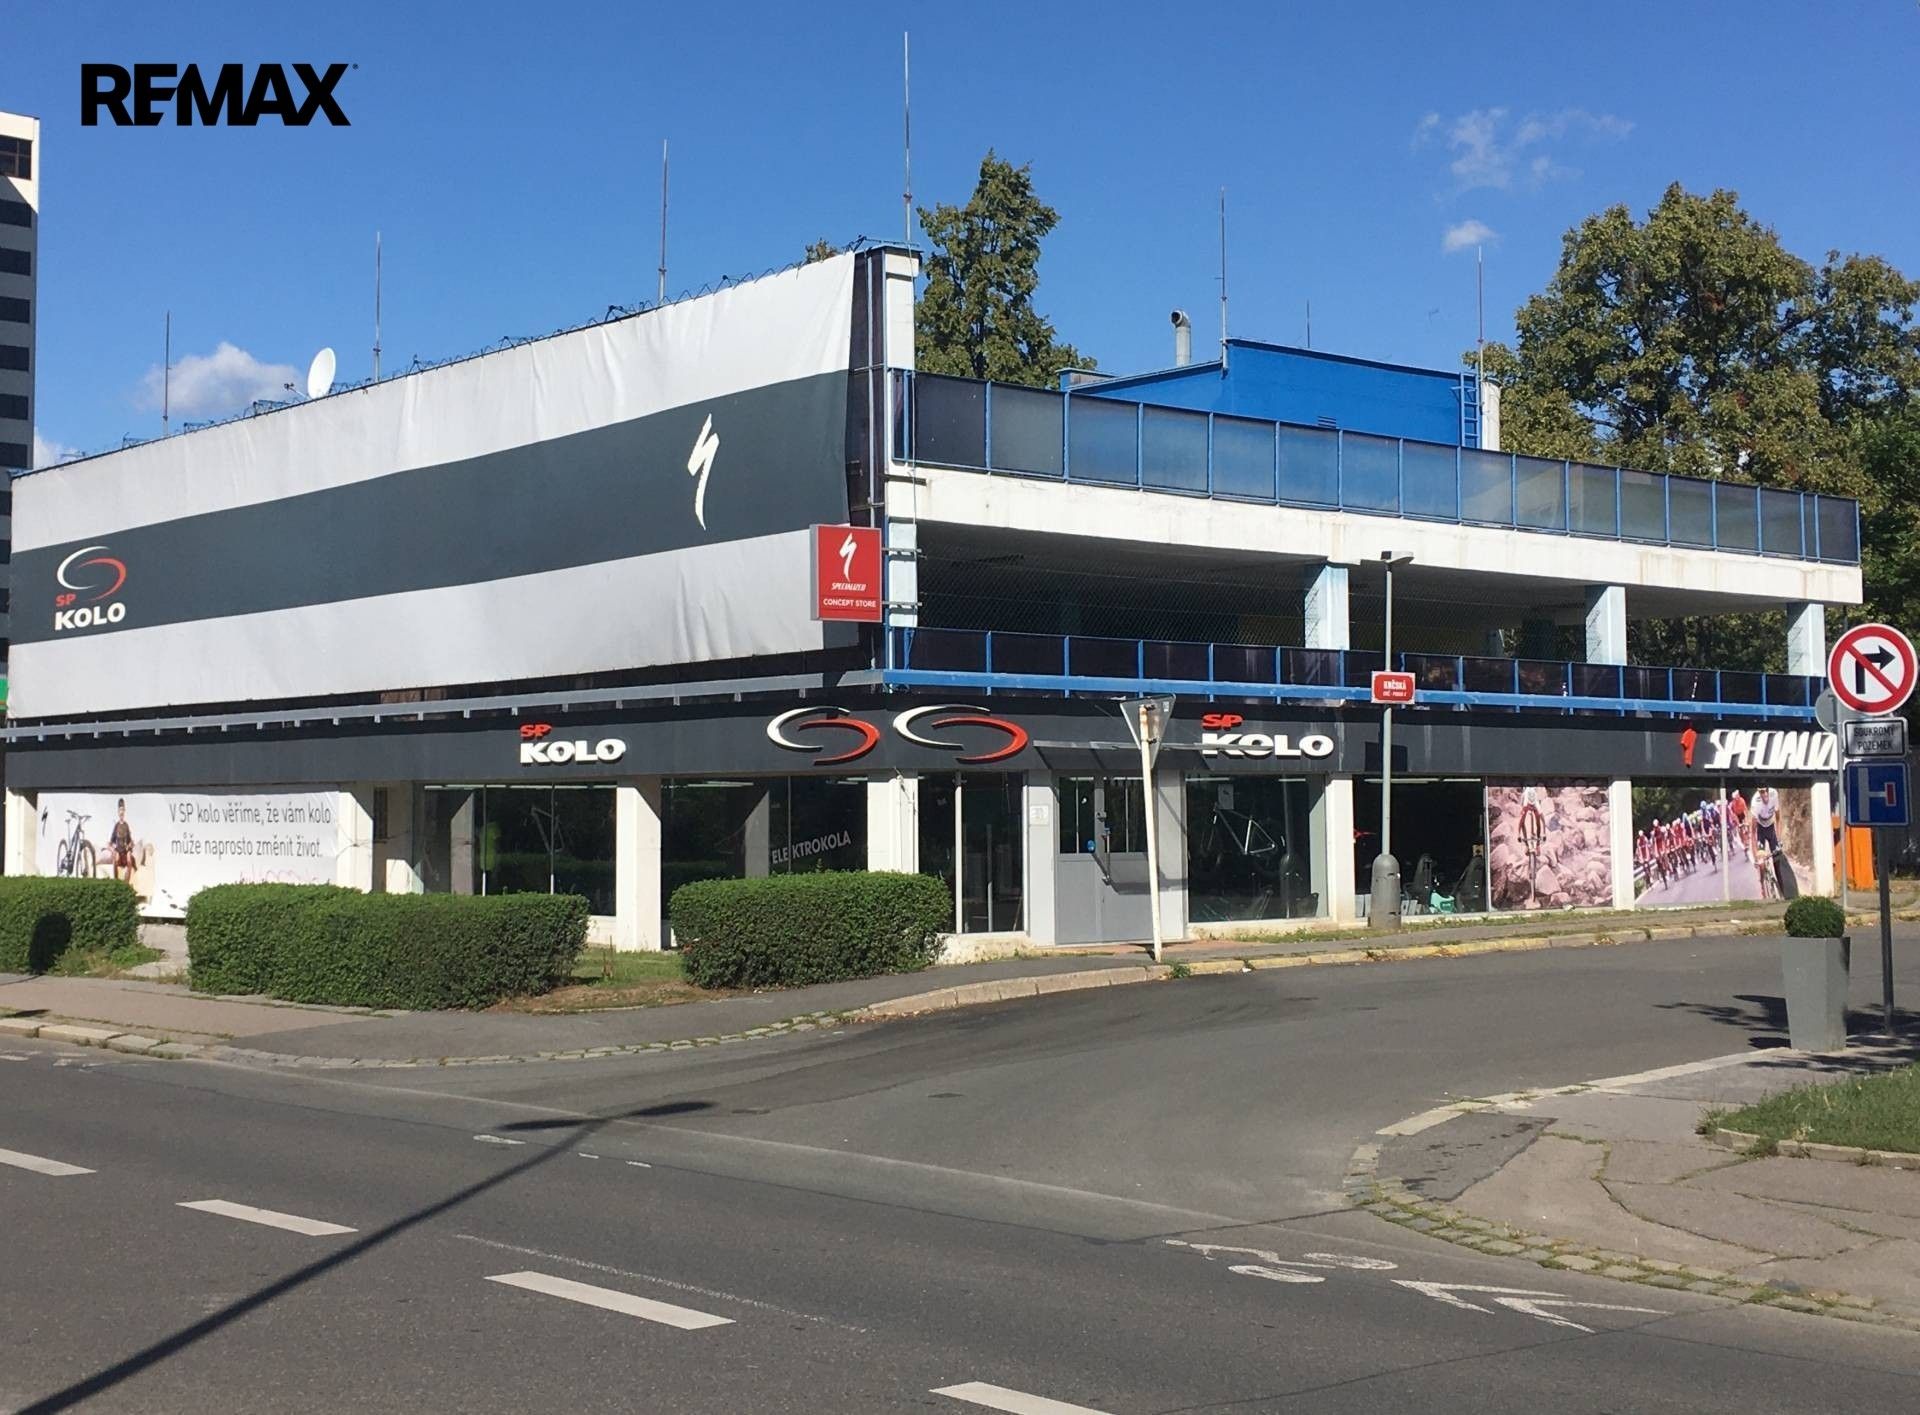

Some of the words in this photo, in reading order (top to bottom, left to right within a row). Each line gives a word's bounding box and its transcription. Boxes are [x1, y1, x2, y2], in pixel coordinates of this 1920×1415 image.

[55, 593, 77, 607] SP
[823, 598, 853, 607] CONCEPT
[856, 600, 876, 608] STORE
[55, 602, 126, 631] KOLO
[520, 724, 553, 738] SP
[1202, 714, 1243, 729] SP
[520, 738, 627, 764] KOLO
[1202, 733, 1335, 757] KOLO
[1704, 729, 1848, 770] SPECIALIZ
[1857, 740, 1893, 751] POZEMEK
[169, 803, 177, 823] V
[179, 803, 194, 823] SP
[197, 802, 220, 823] kolo
[222, 802, 265, 826] věříme,
[267, 802, 279, 823] že
[282, 801, 306, 823] vám
[308, 801, 331, 823] kolo
[171, 832, 201, 855] může
[204, 836, 253, 860] naprosto
[256, 834, 293, 857] změnit
[771, 830, 852, 864] ELEKTROKOLA
